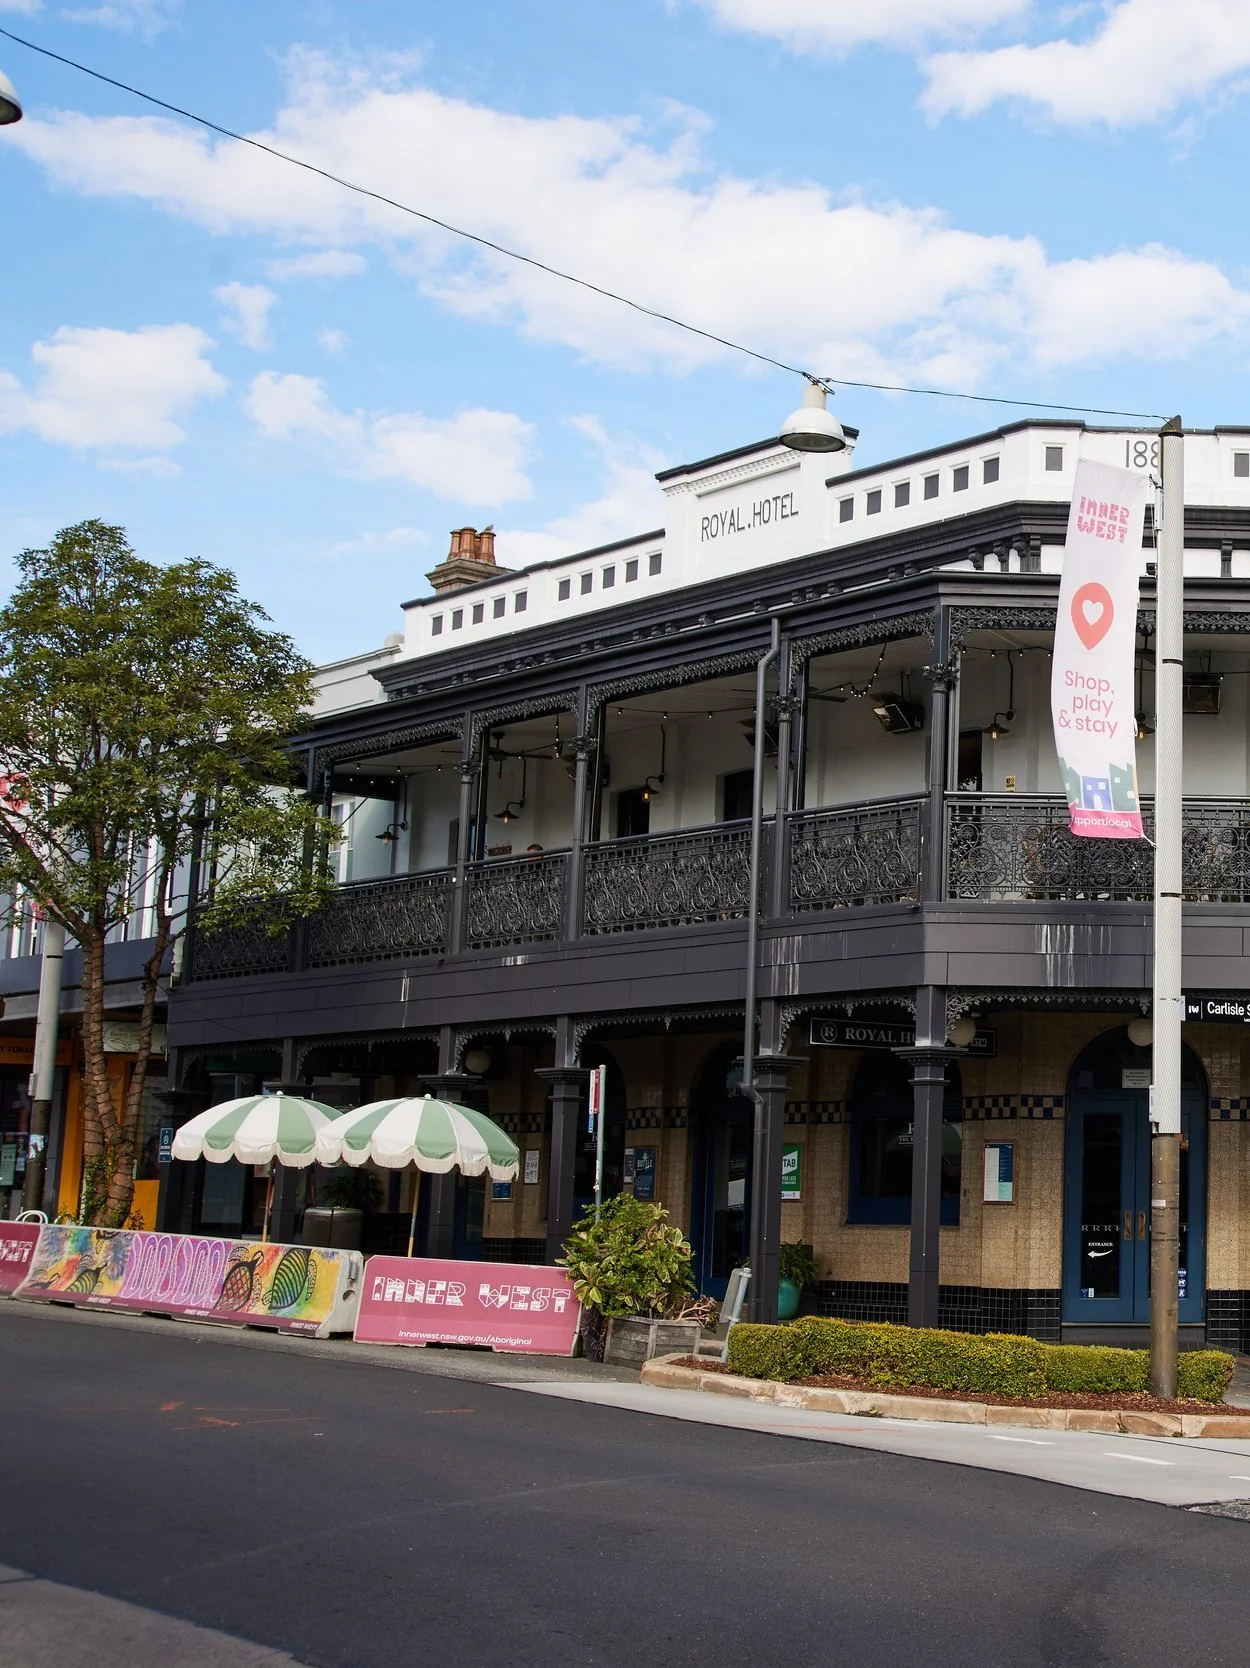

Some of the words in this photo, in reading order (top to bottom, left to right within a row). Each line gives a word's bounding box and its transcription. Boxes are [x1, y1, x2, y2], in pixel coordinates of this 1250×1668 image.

[1079, 496, 1130, 525] INNER
[1077, 516, 1128, 544] WEST
[1064, 670, 1115, 696] Shop,
[1072, 694, 1114, 718] play
[1207, 1001, 1245, 1016] Carlisle
[844, 1027, 897, 1043] ROYAL
[783, 1158, 796, 1168] TAB
[371, 1276, 467, 1307] INNER
[478, 1283, 571, 1313] WEST
